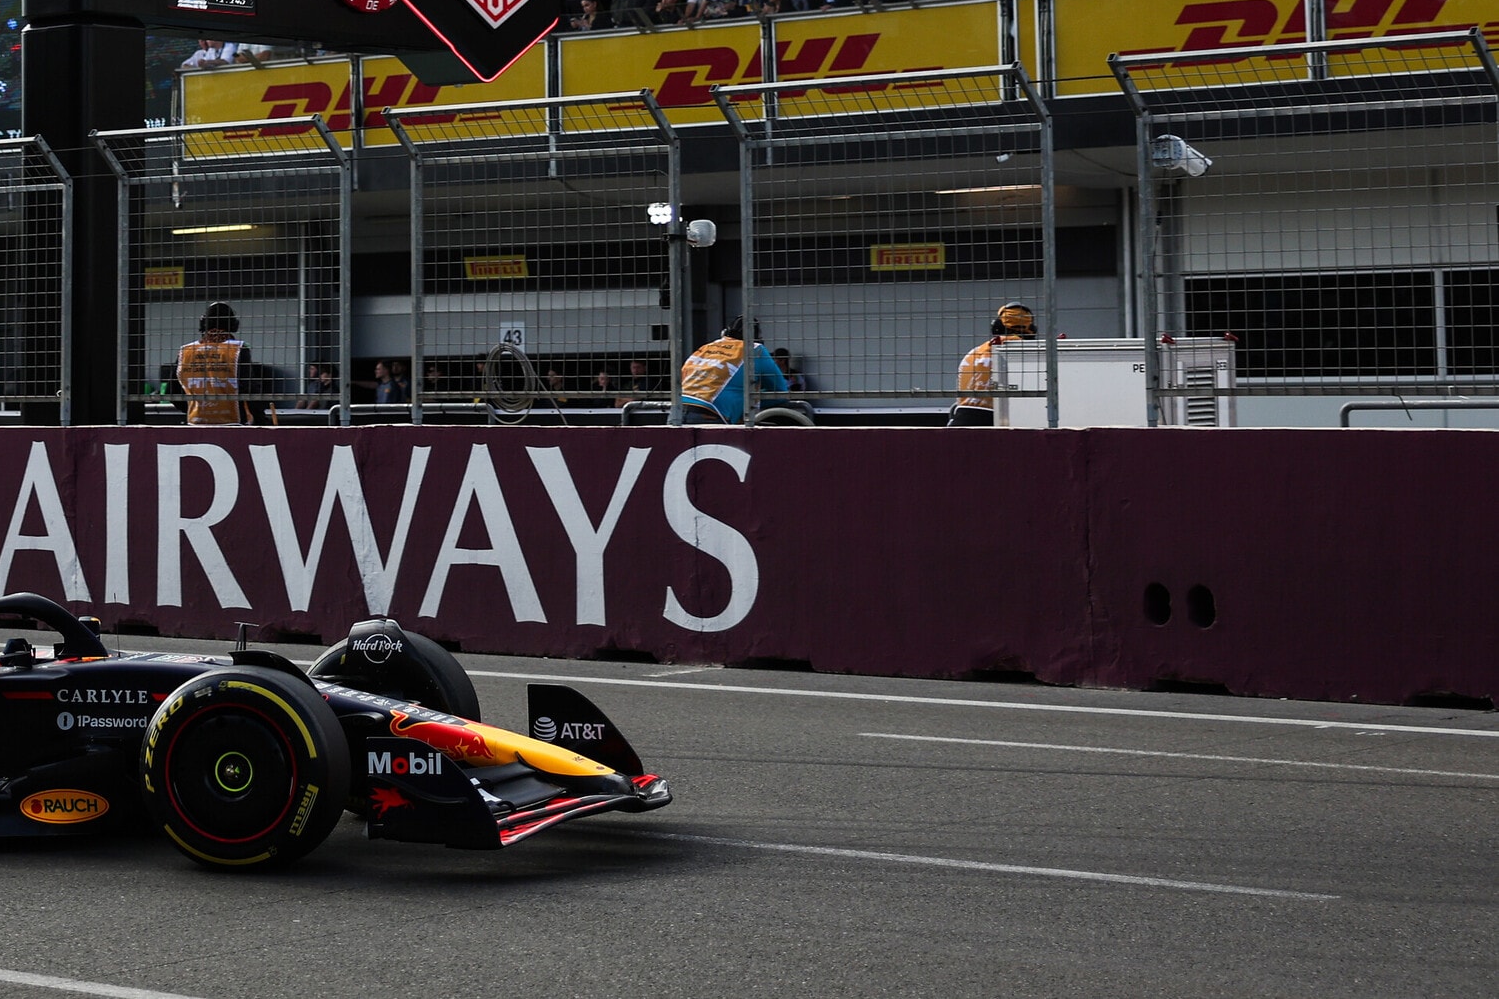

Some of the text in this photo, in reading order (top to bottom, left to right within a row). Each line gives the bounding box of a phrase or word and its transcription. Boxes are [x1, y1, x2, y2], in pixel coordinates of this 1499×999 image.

[653, 33, 894, 106] DHL
[258, 74, 457, 137] DHL
[876, 248, 939, 265] PIRELLI
[470, 260, 522, 276] PIRELLI
[503, 329, 522, 346] 43
[353, 639, 378, 651] Hard
[56, 689, 148, 703] CARLYLE
[77, 715, 147, 728] 1Password
[144, 695, 184, 769] ZERO
[560, 723, 605, 740] AT&T
[367, 752, 442, 775] Mobil
[44, 799, 99, 812] RAUCH
[289, 784, 319, 837] PIRELLI
